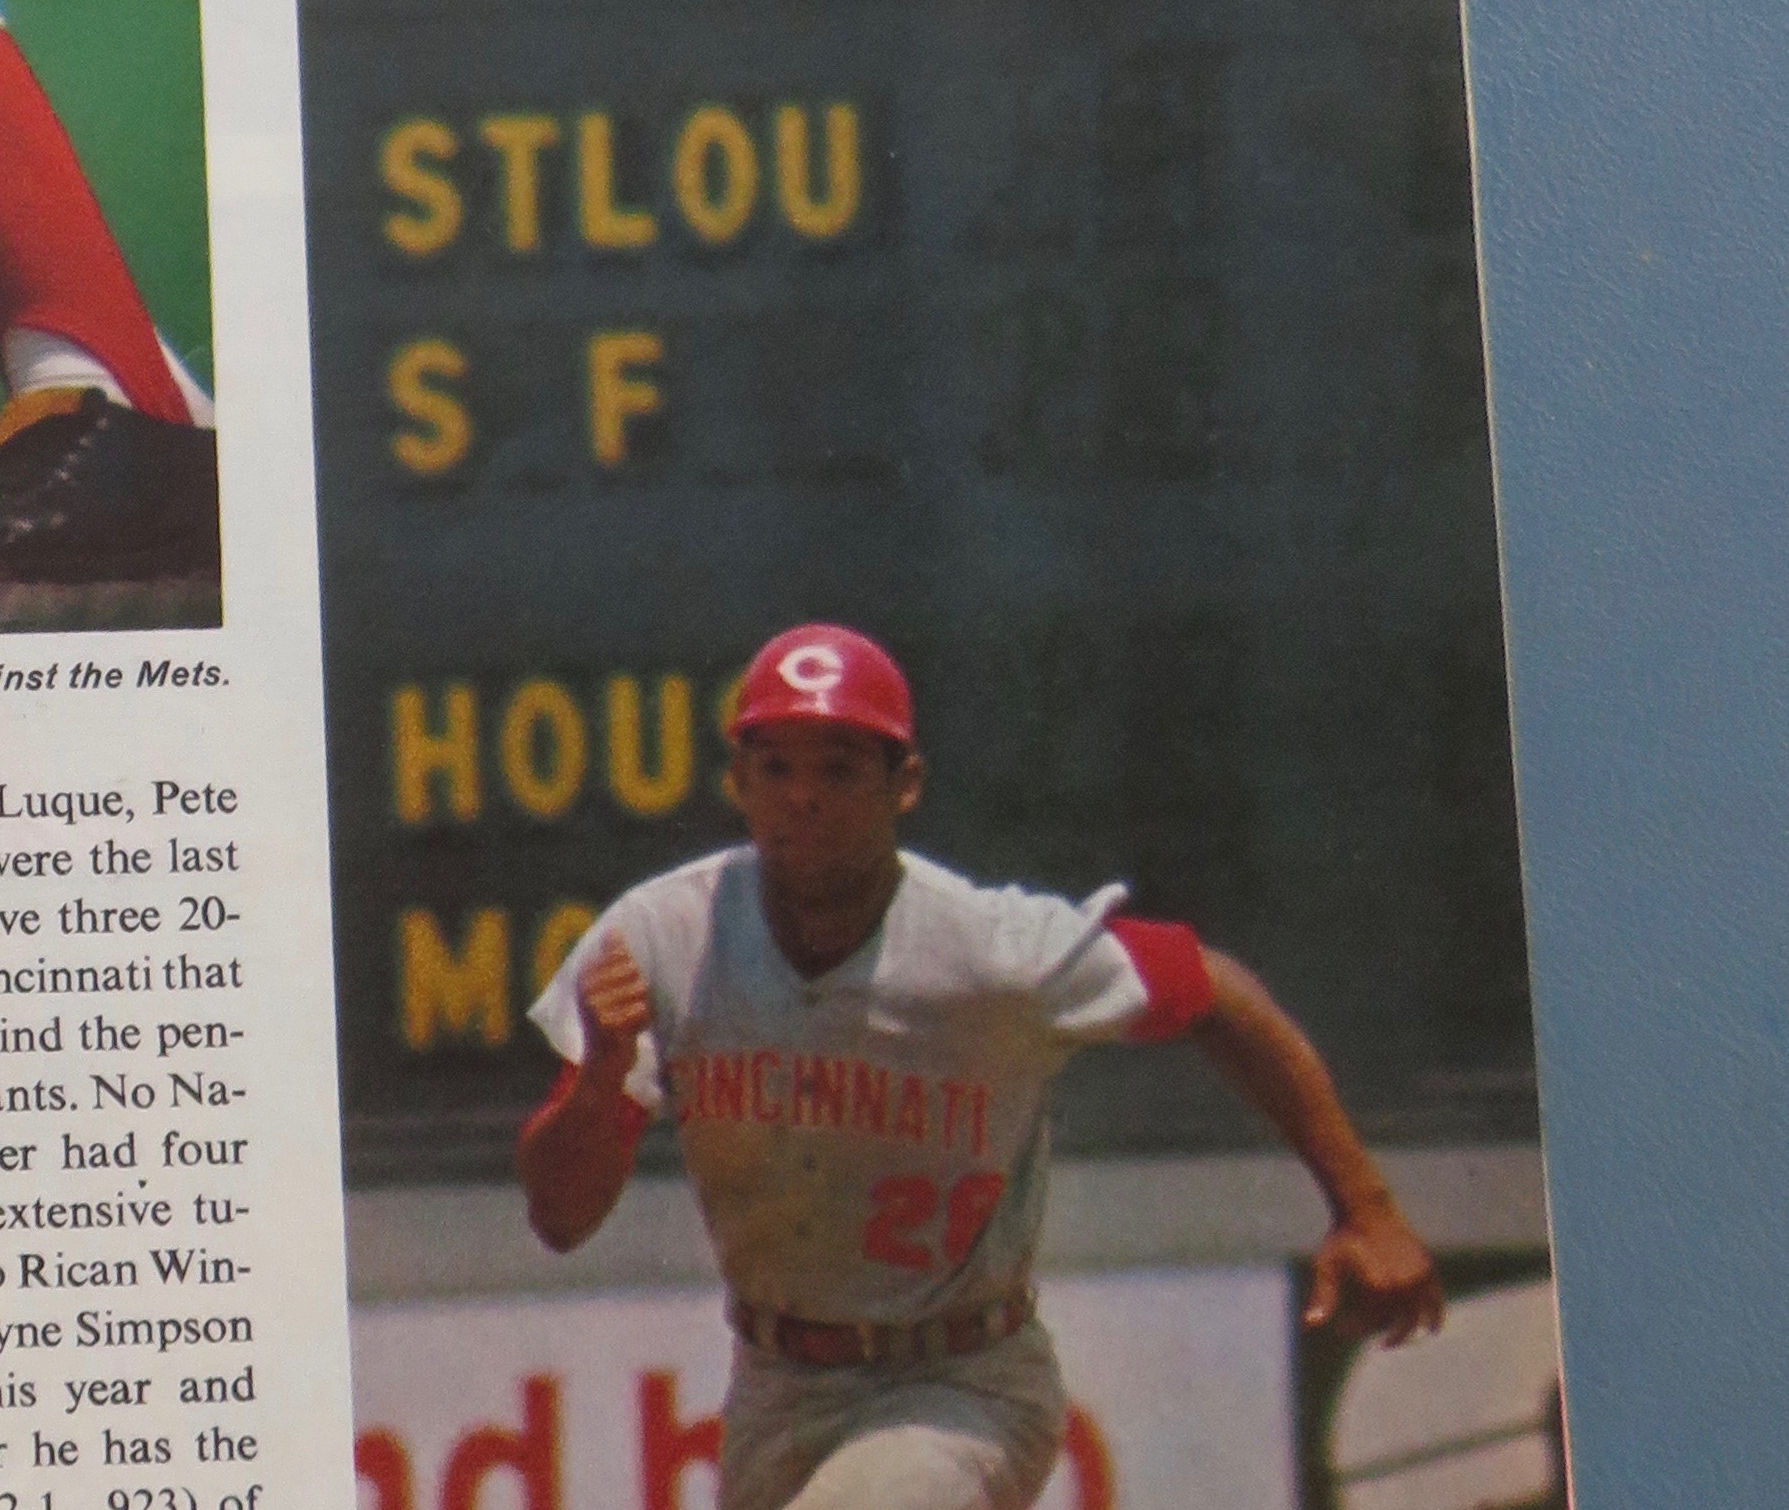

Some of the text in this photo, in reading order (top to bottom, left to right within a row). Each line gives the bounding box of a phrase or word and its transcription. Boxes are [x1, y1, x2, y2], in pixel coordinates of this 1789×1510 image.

[378, 101, 863, 258] STLOU
[385, 329, 665, 476] S F
[68, 660, 124, 690] the
[135, 659, 230, 689] Mets.
[151, 780, 238, 816] Pete
[57, 897, 162, 935] three
[178, 895, 241, 932] 20-
[89, 1073, 156, 1110] No
[167, 1071, 247, 1108] Na-
[193, 1193, 250, 1226] tu-
[76, 1309, 254, 1353] Simpson
